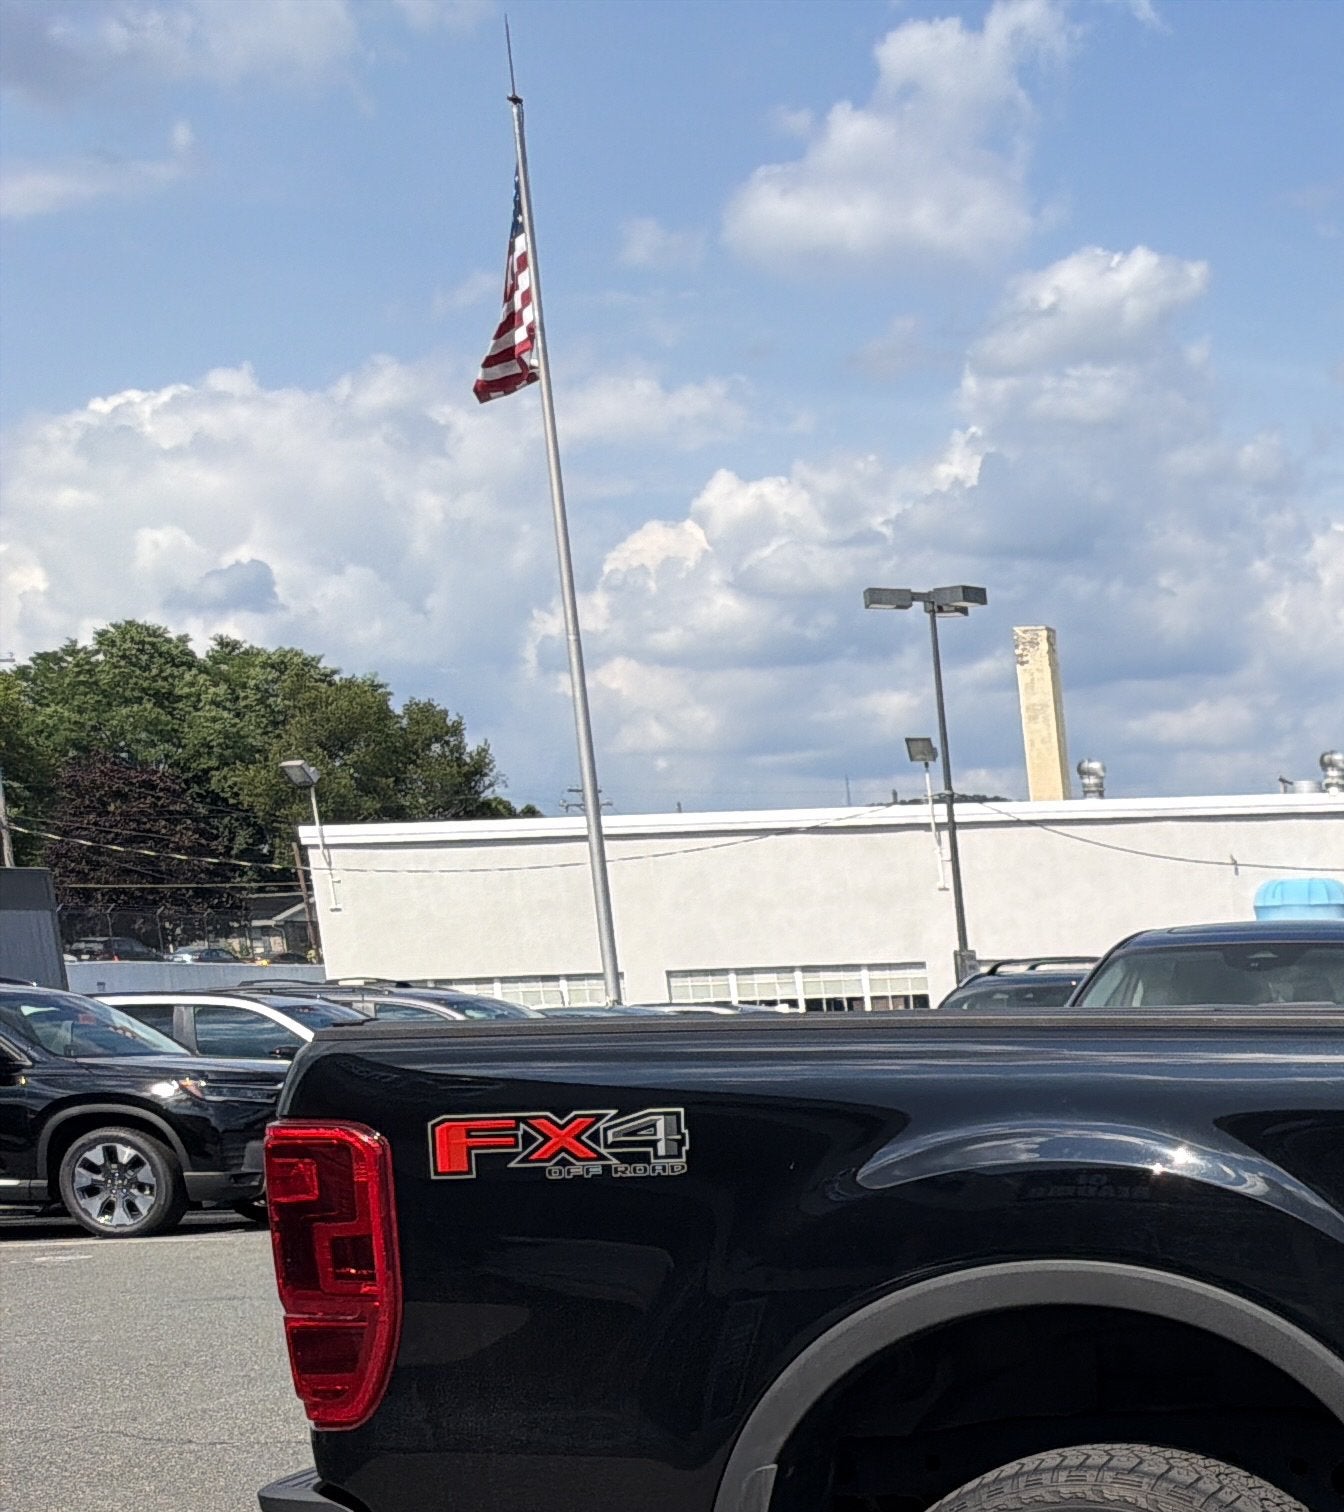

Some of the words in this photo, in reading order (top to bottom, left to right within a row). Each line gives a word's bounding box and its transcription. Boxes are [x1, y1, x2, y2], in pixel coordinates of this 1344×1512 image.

[428, 1108, 689, 1180] FX4
[546, 1165, 603, 1179] OFF
[612, 1163, 688, 1178] ROAD
